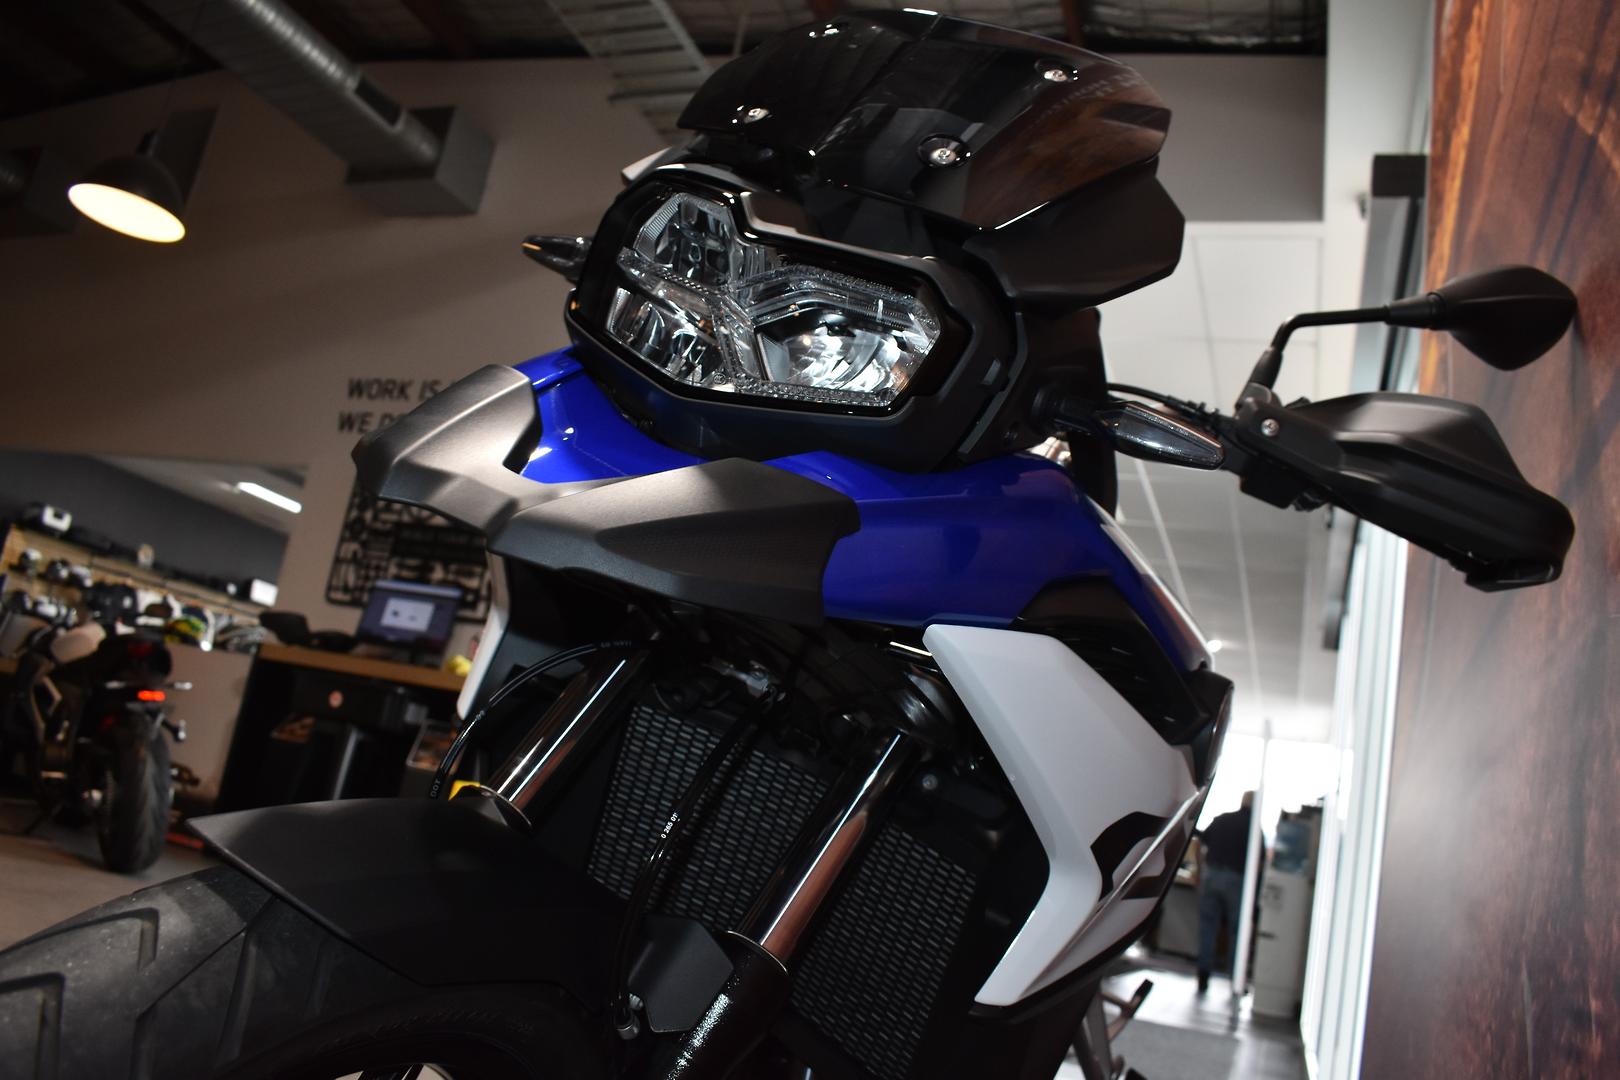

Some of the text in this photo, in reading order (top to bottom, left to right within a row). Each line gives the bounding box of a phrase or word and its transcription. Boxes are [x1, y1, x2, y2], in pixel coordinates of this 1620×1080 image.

[347, 378, 442, 401] WORK IS
[338, 412, 372, 433] WE
